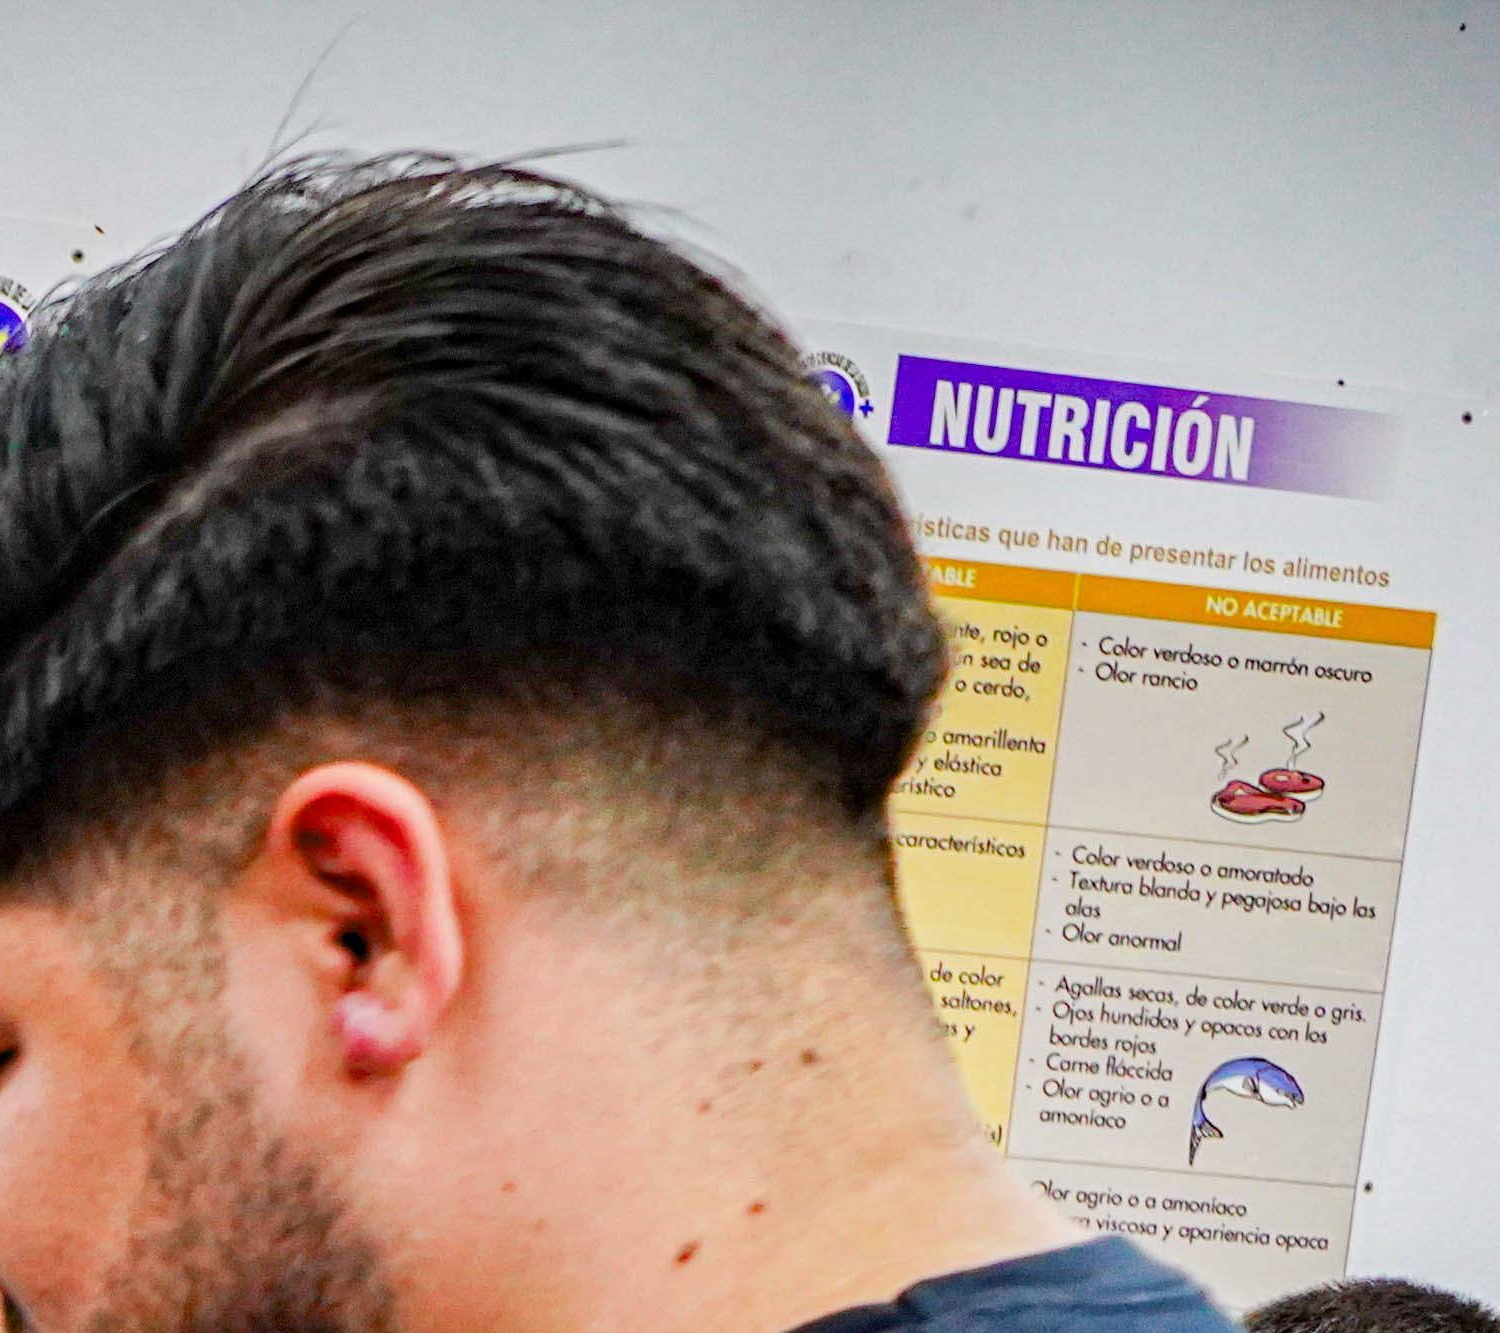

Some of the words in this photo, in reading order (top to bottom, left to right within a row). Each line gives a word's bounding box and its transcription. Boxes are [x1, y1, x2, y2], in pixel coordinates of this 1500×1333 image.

[929, 380, 1255, 483] NUTRICIÓN
[997, 528, 1040, 551] que
[1046, 527, 1088, 555] han
[1095, 534, 1123, 558] de
[1128, 543, 1238, 571] presentar
[1243, 550, 1276, 575] los
[1282, 556, 1391, 589] alimentos
[1205, 596, 1239, 617] NO
[1243, 601, 1341, 628] ACEPTABLE
[1094, 660, 1138, 684] Olor
[1141, 671, 1199, 691] rancio
[1098, 635, 1148, 664] Color
[1153, 643, 1223, 668] verdoso
[1227, 656, 1240, 670] o
[1244, 657, 1309, 677] marrón
[1314, 665, 1373, 684] oscuro
